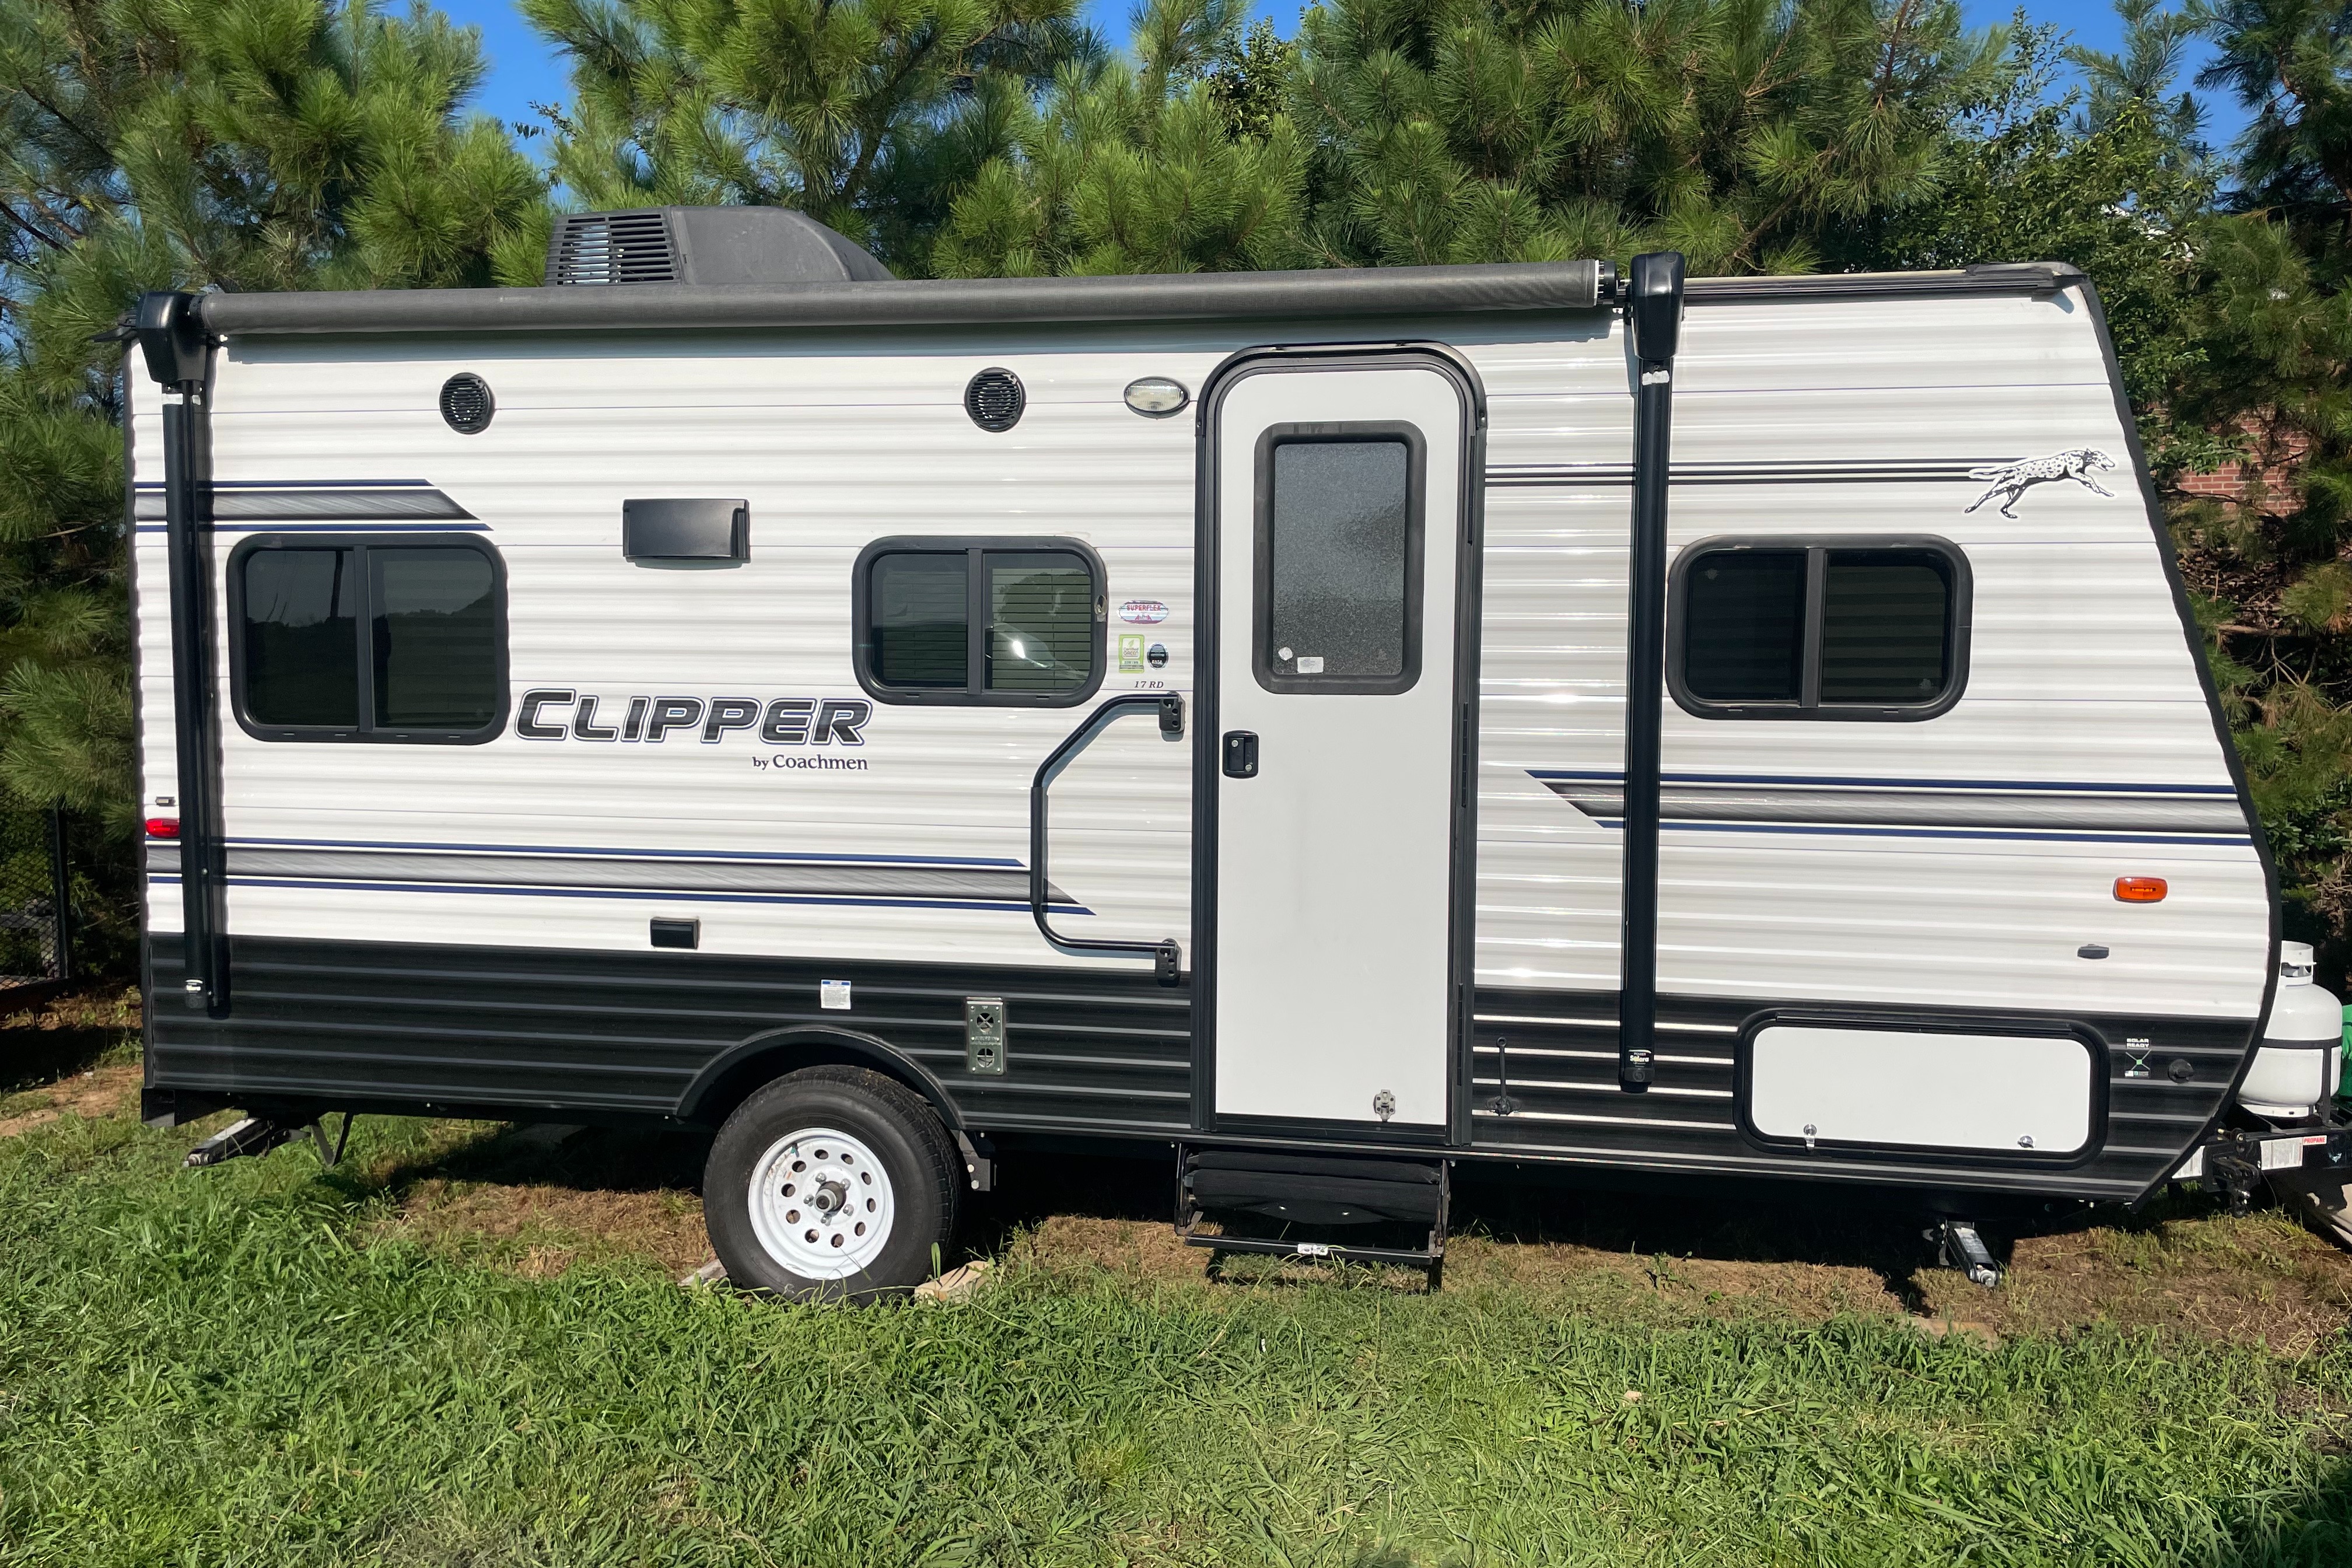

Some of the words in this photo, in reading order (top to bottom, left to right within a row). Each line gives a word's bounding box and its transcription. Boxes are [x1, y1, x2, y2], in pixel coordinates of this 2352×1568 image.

[514, 688, 873, 746] CLIPPER
[752, 756, 769, 770] by
[773, 754, 868, 770] Coachmen
